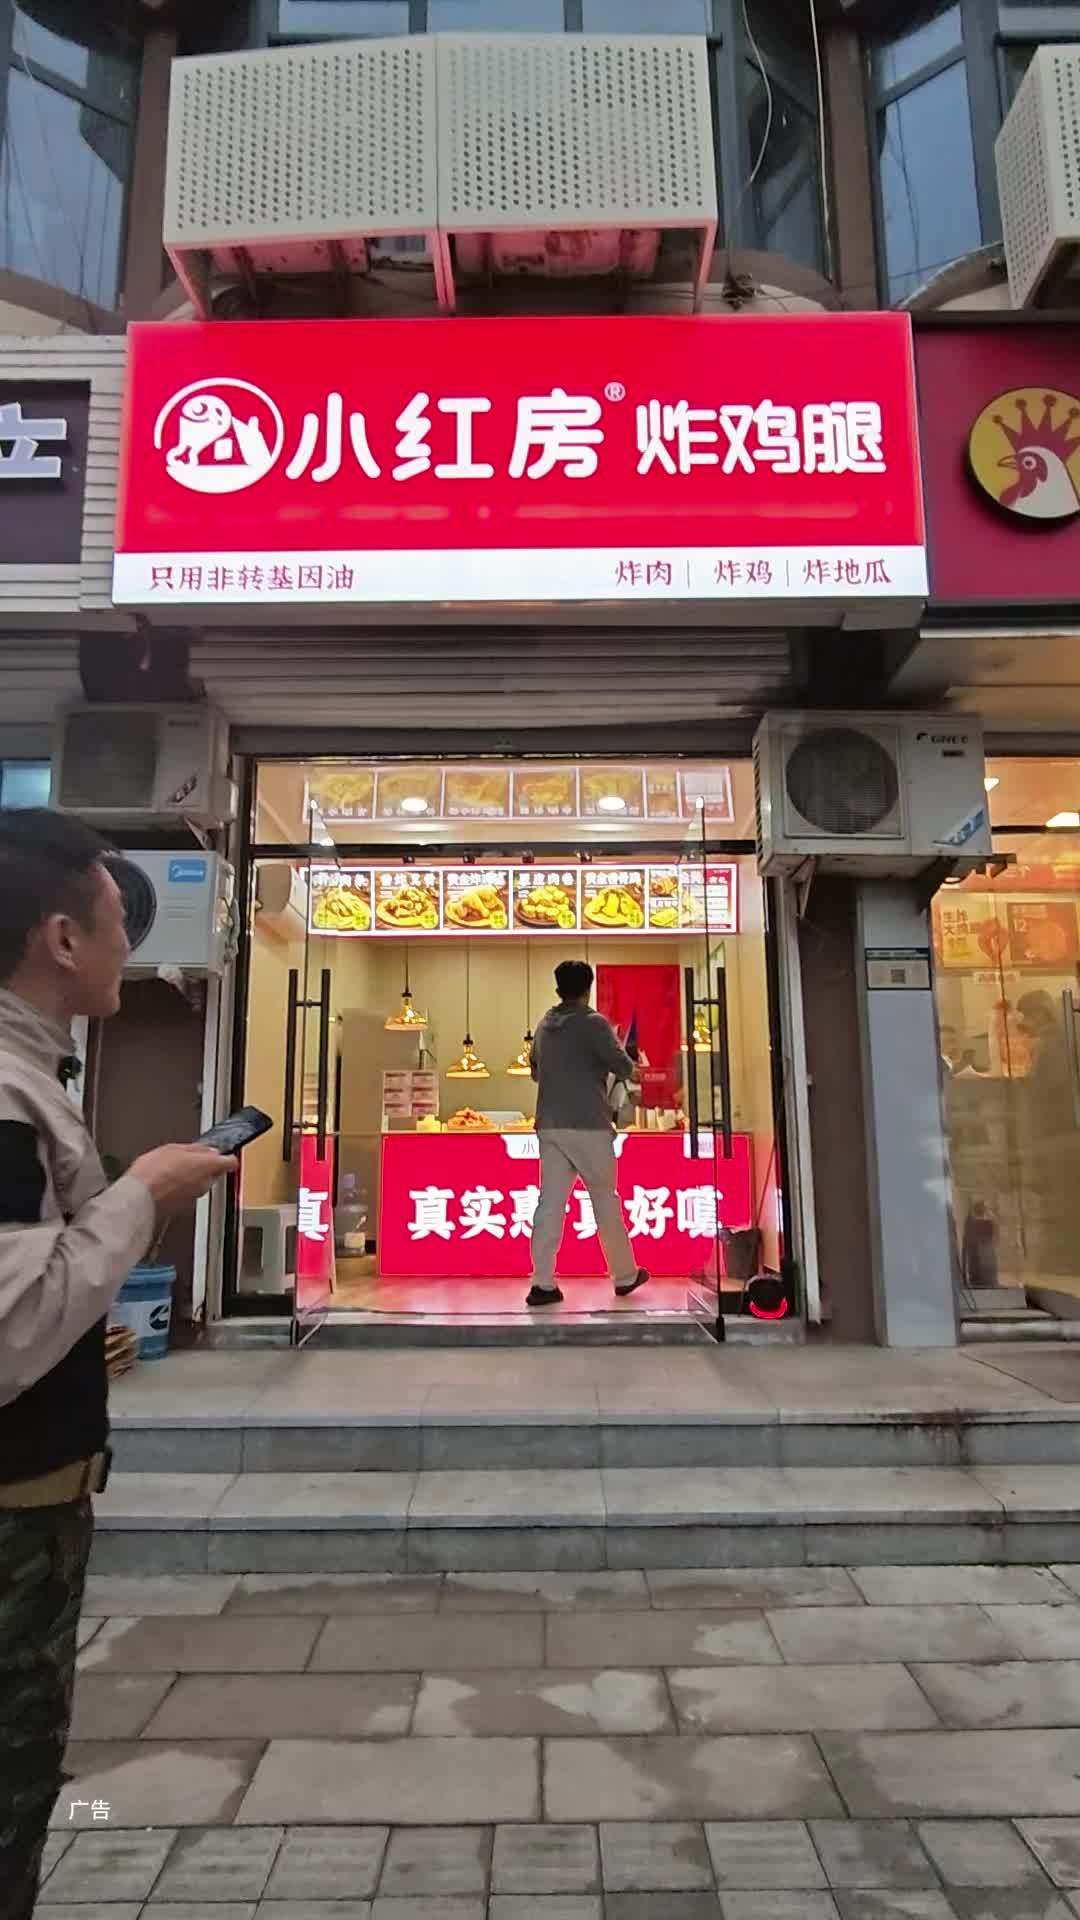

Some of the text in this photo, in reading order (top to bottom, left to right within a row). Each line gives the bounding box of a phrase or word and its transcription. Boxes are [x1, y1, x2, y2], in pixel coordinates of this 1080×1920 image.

[635, 398, 887, 475] 炸鸡腿
[150, 564, 354, 591] 只用非转基因油
[614, 558, 892, 587] 炸肉 炸鸡 炸地瓜
